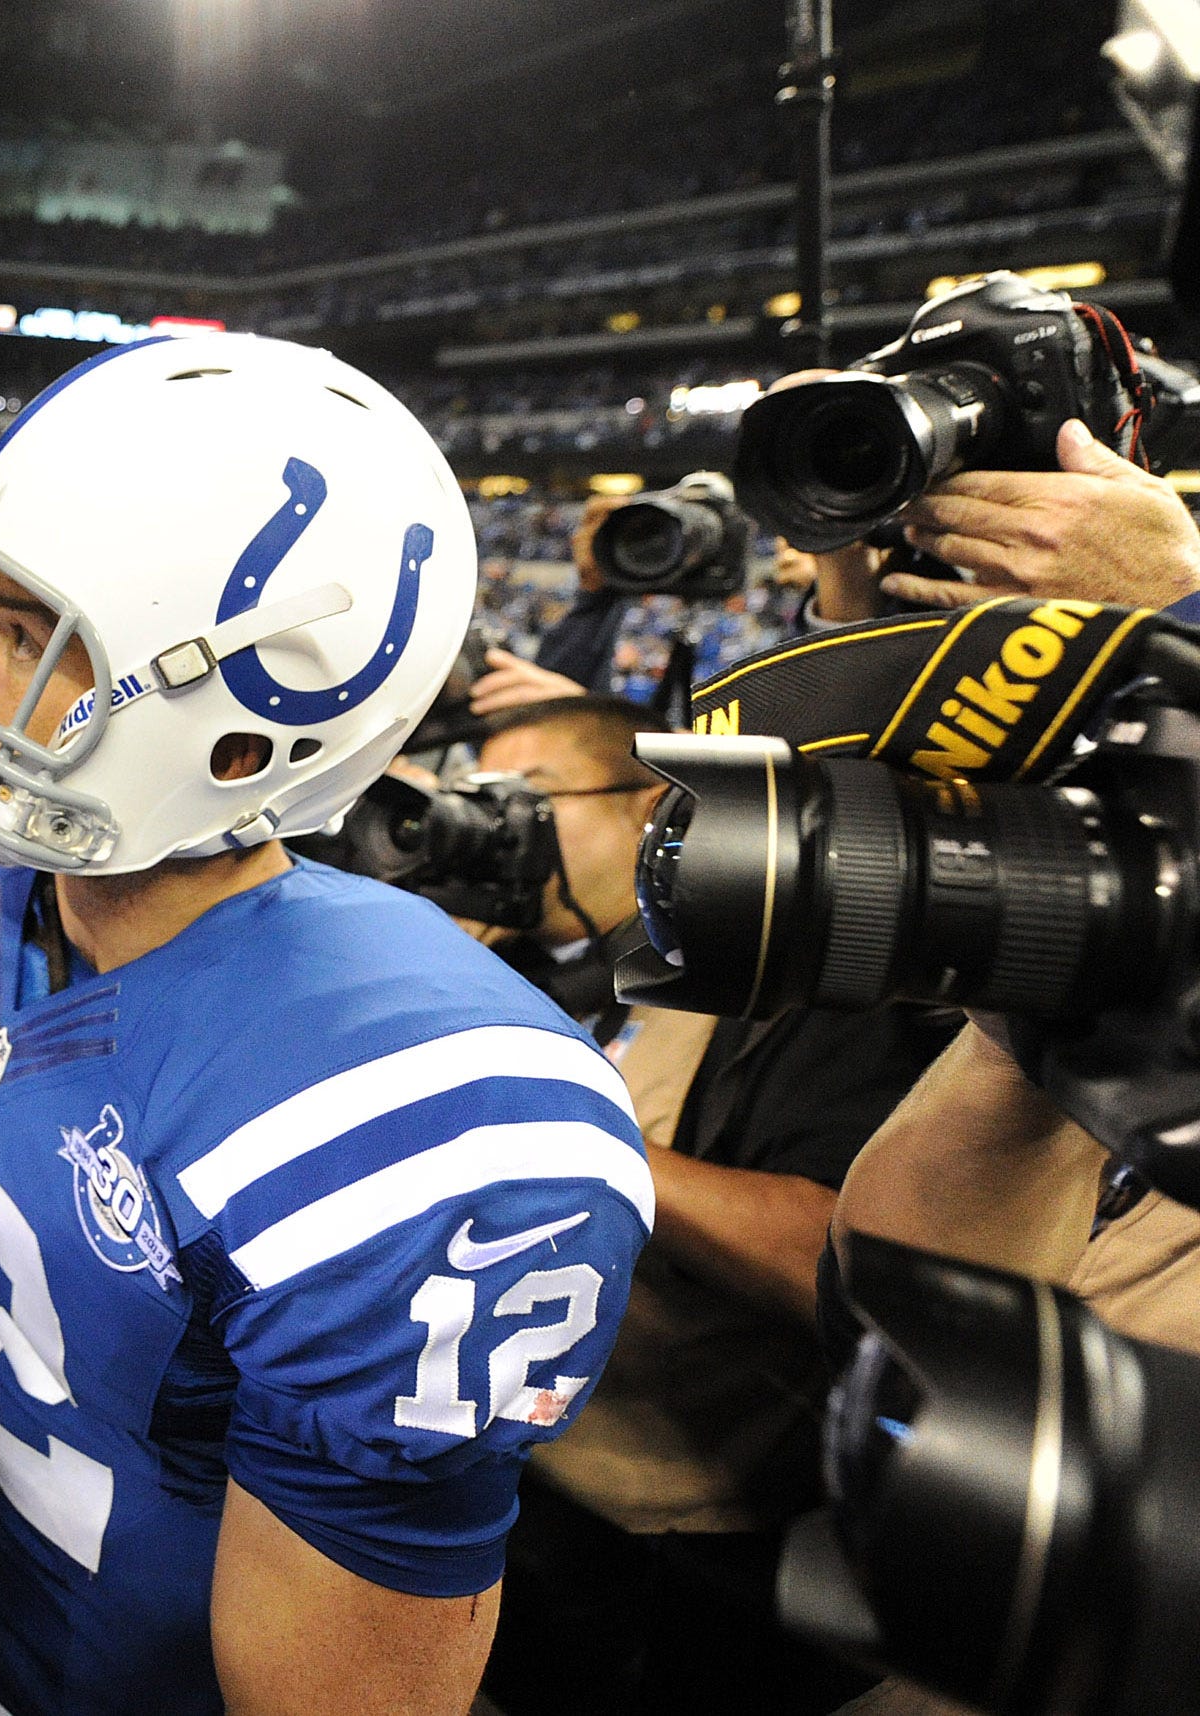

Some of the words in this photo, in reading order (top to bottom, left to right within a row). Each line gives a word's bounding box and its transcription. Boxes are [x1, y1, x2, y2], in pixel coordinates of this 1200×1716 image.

[910, 599, 1104, 782] Nikon
[90, 1146, 143, 1233] 30
[141, 1231, 165, 1264] 2013
[393, 1263, 604, 1438] 12
